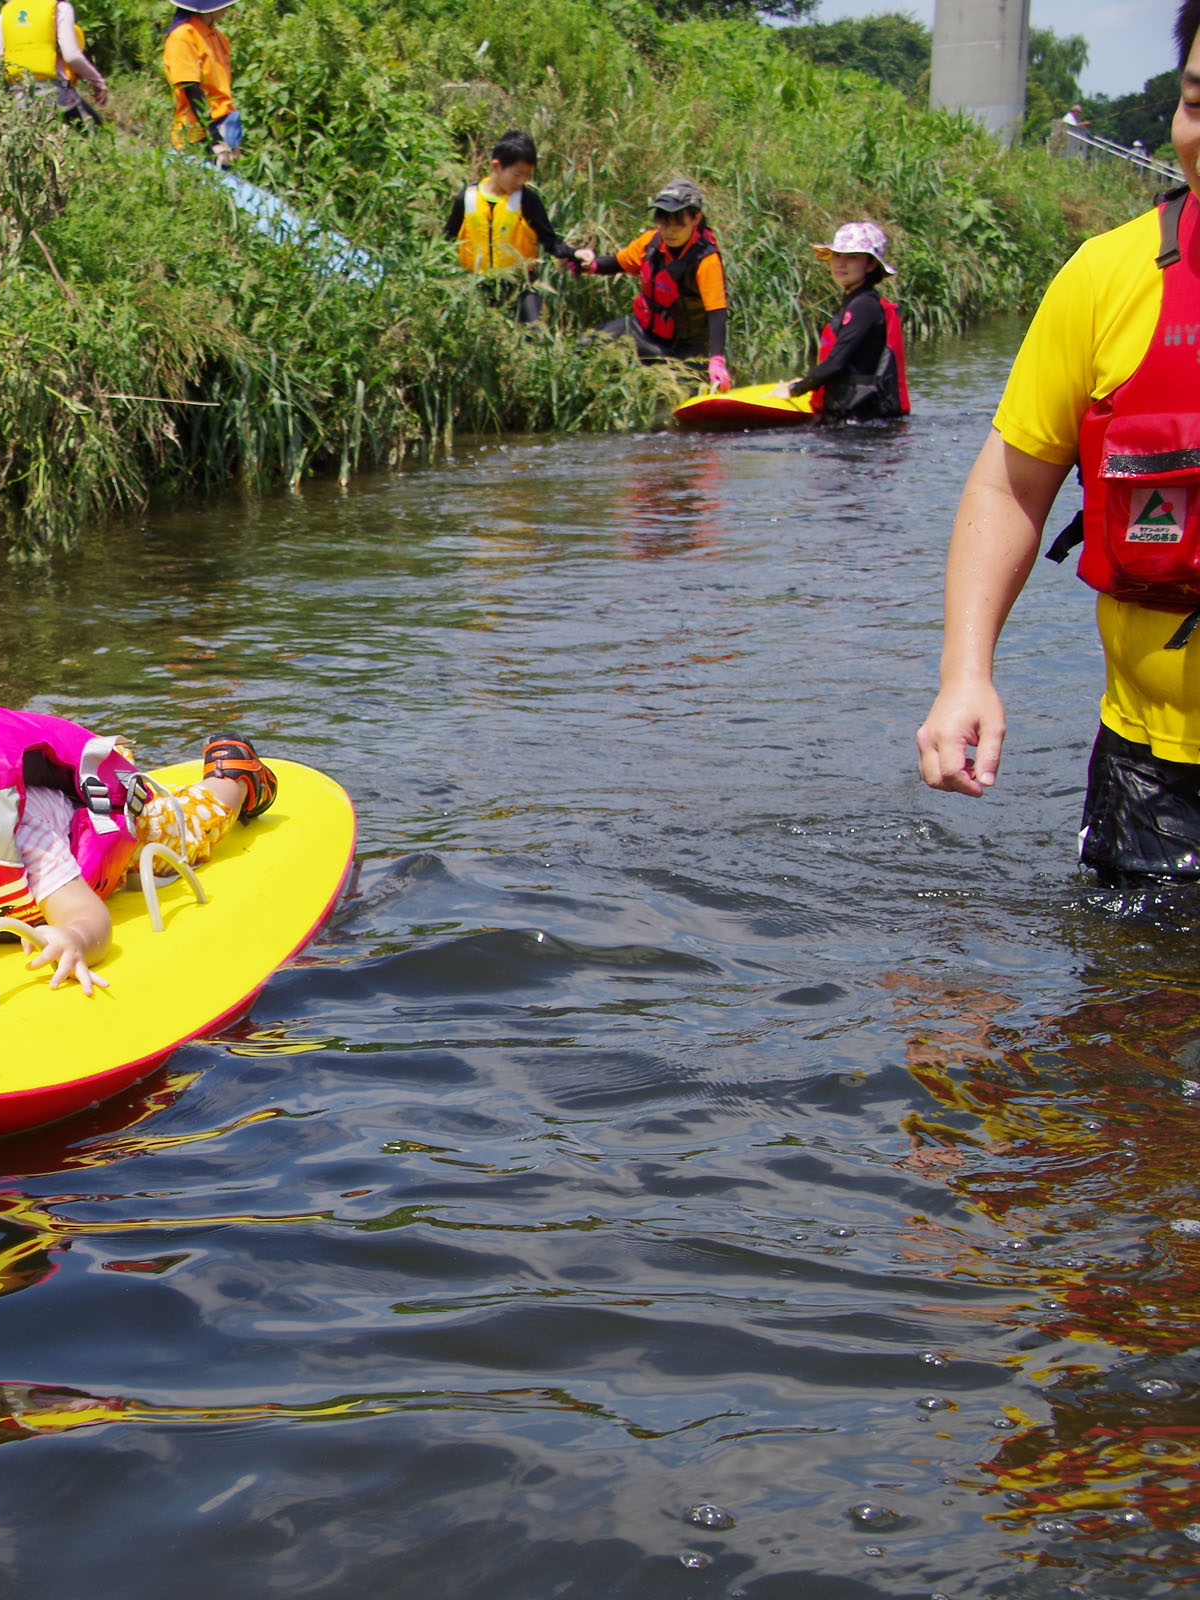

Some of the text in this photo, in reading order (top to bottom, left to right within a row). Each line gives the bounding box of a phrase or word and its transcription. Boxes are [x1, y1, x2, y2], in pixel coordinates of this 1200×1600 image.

[1129, 532, 1179, 542] みどりの基金
